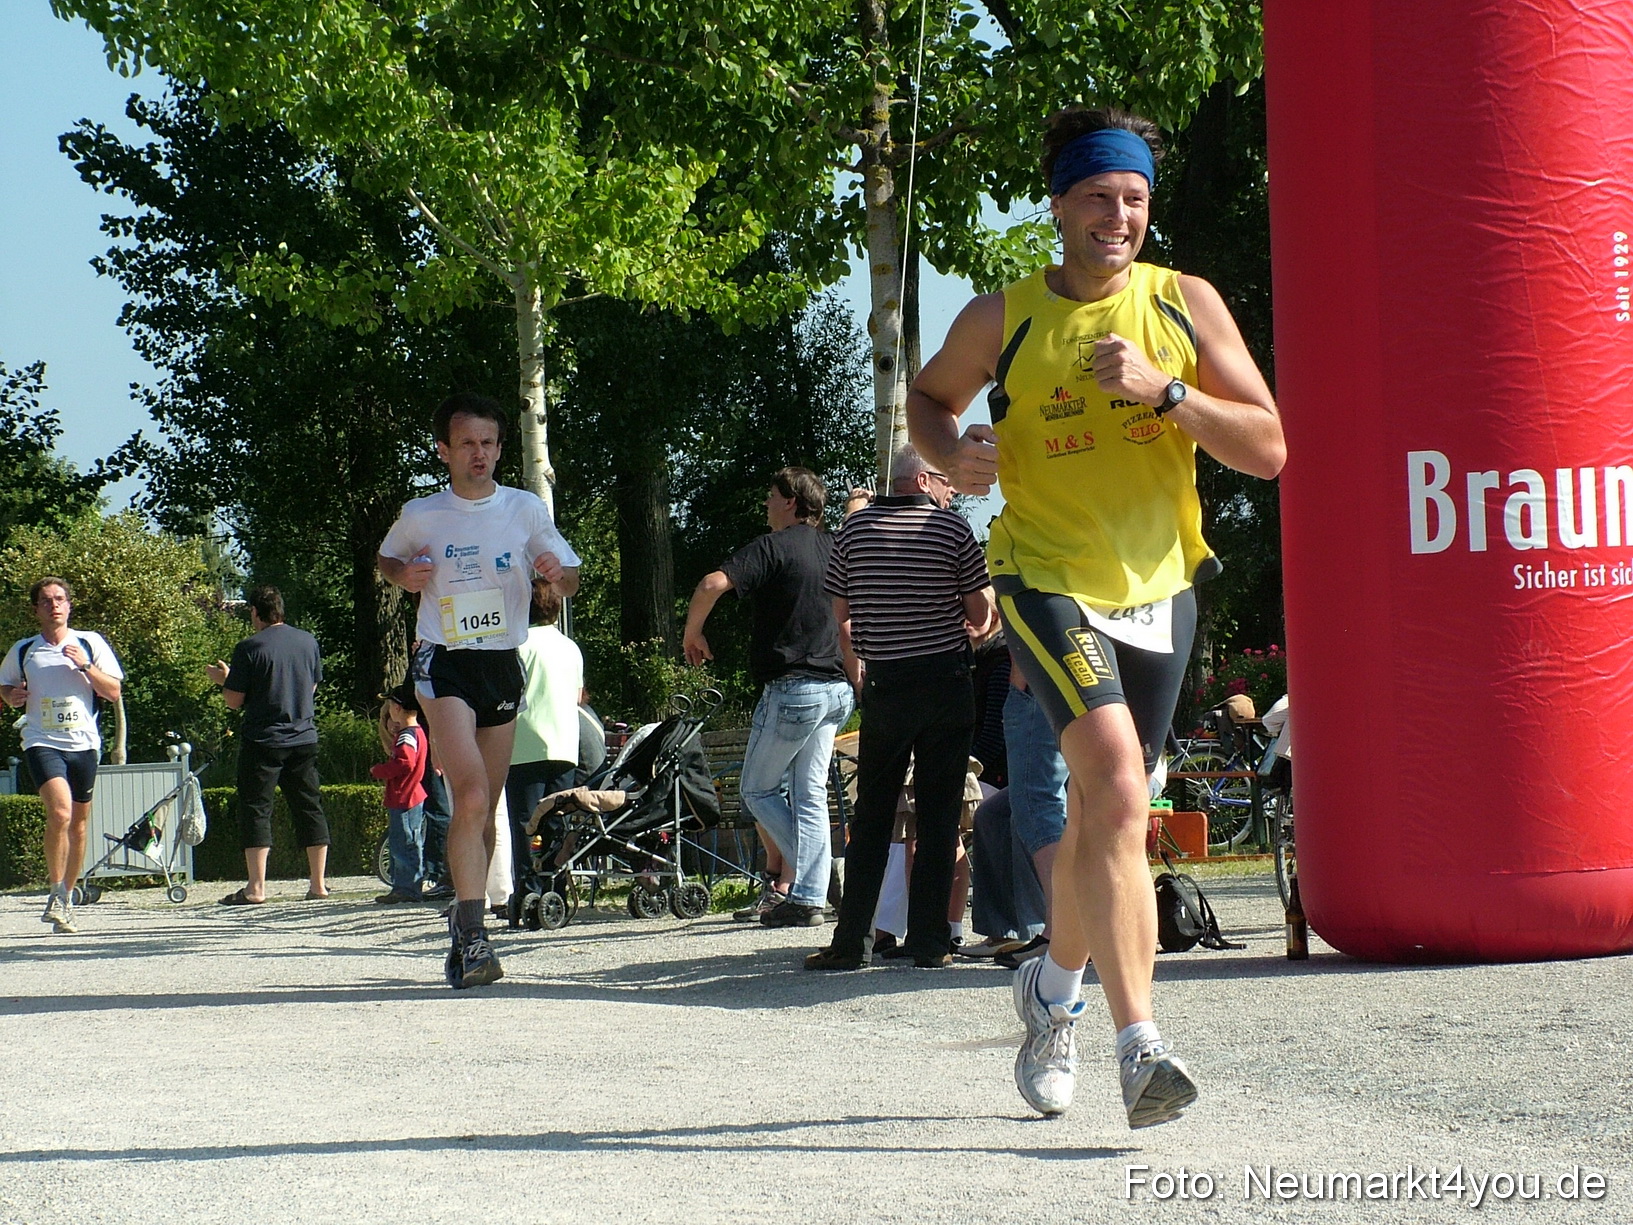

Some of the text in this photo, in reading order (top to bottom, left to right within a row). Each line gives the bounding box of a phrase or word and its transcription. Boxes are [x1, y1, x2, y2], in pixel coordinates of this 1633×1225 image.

[1613, 231, 1631, 322] Seit 1929
[1130, 422, 1161, 438] ELIO
[1044, 438, 1059, 454] M
[1065, 434, 1079, 450] &
[1083, 431, 1095, 446] S
[1408, 450, 1633, 555] Braun
[445, 544, 457, 558] 6.
[1513, 558, 1633, 590] Sicher ist sic
[460, 611, 501, 631] 1045
[1070, 654, 1094, 683] Team
[57, 711, 79, 723] 945
